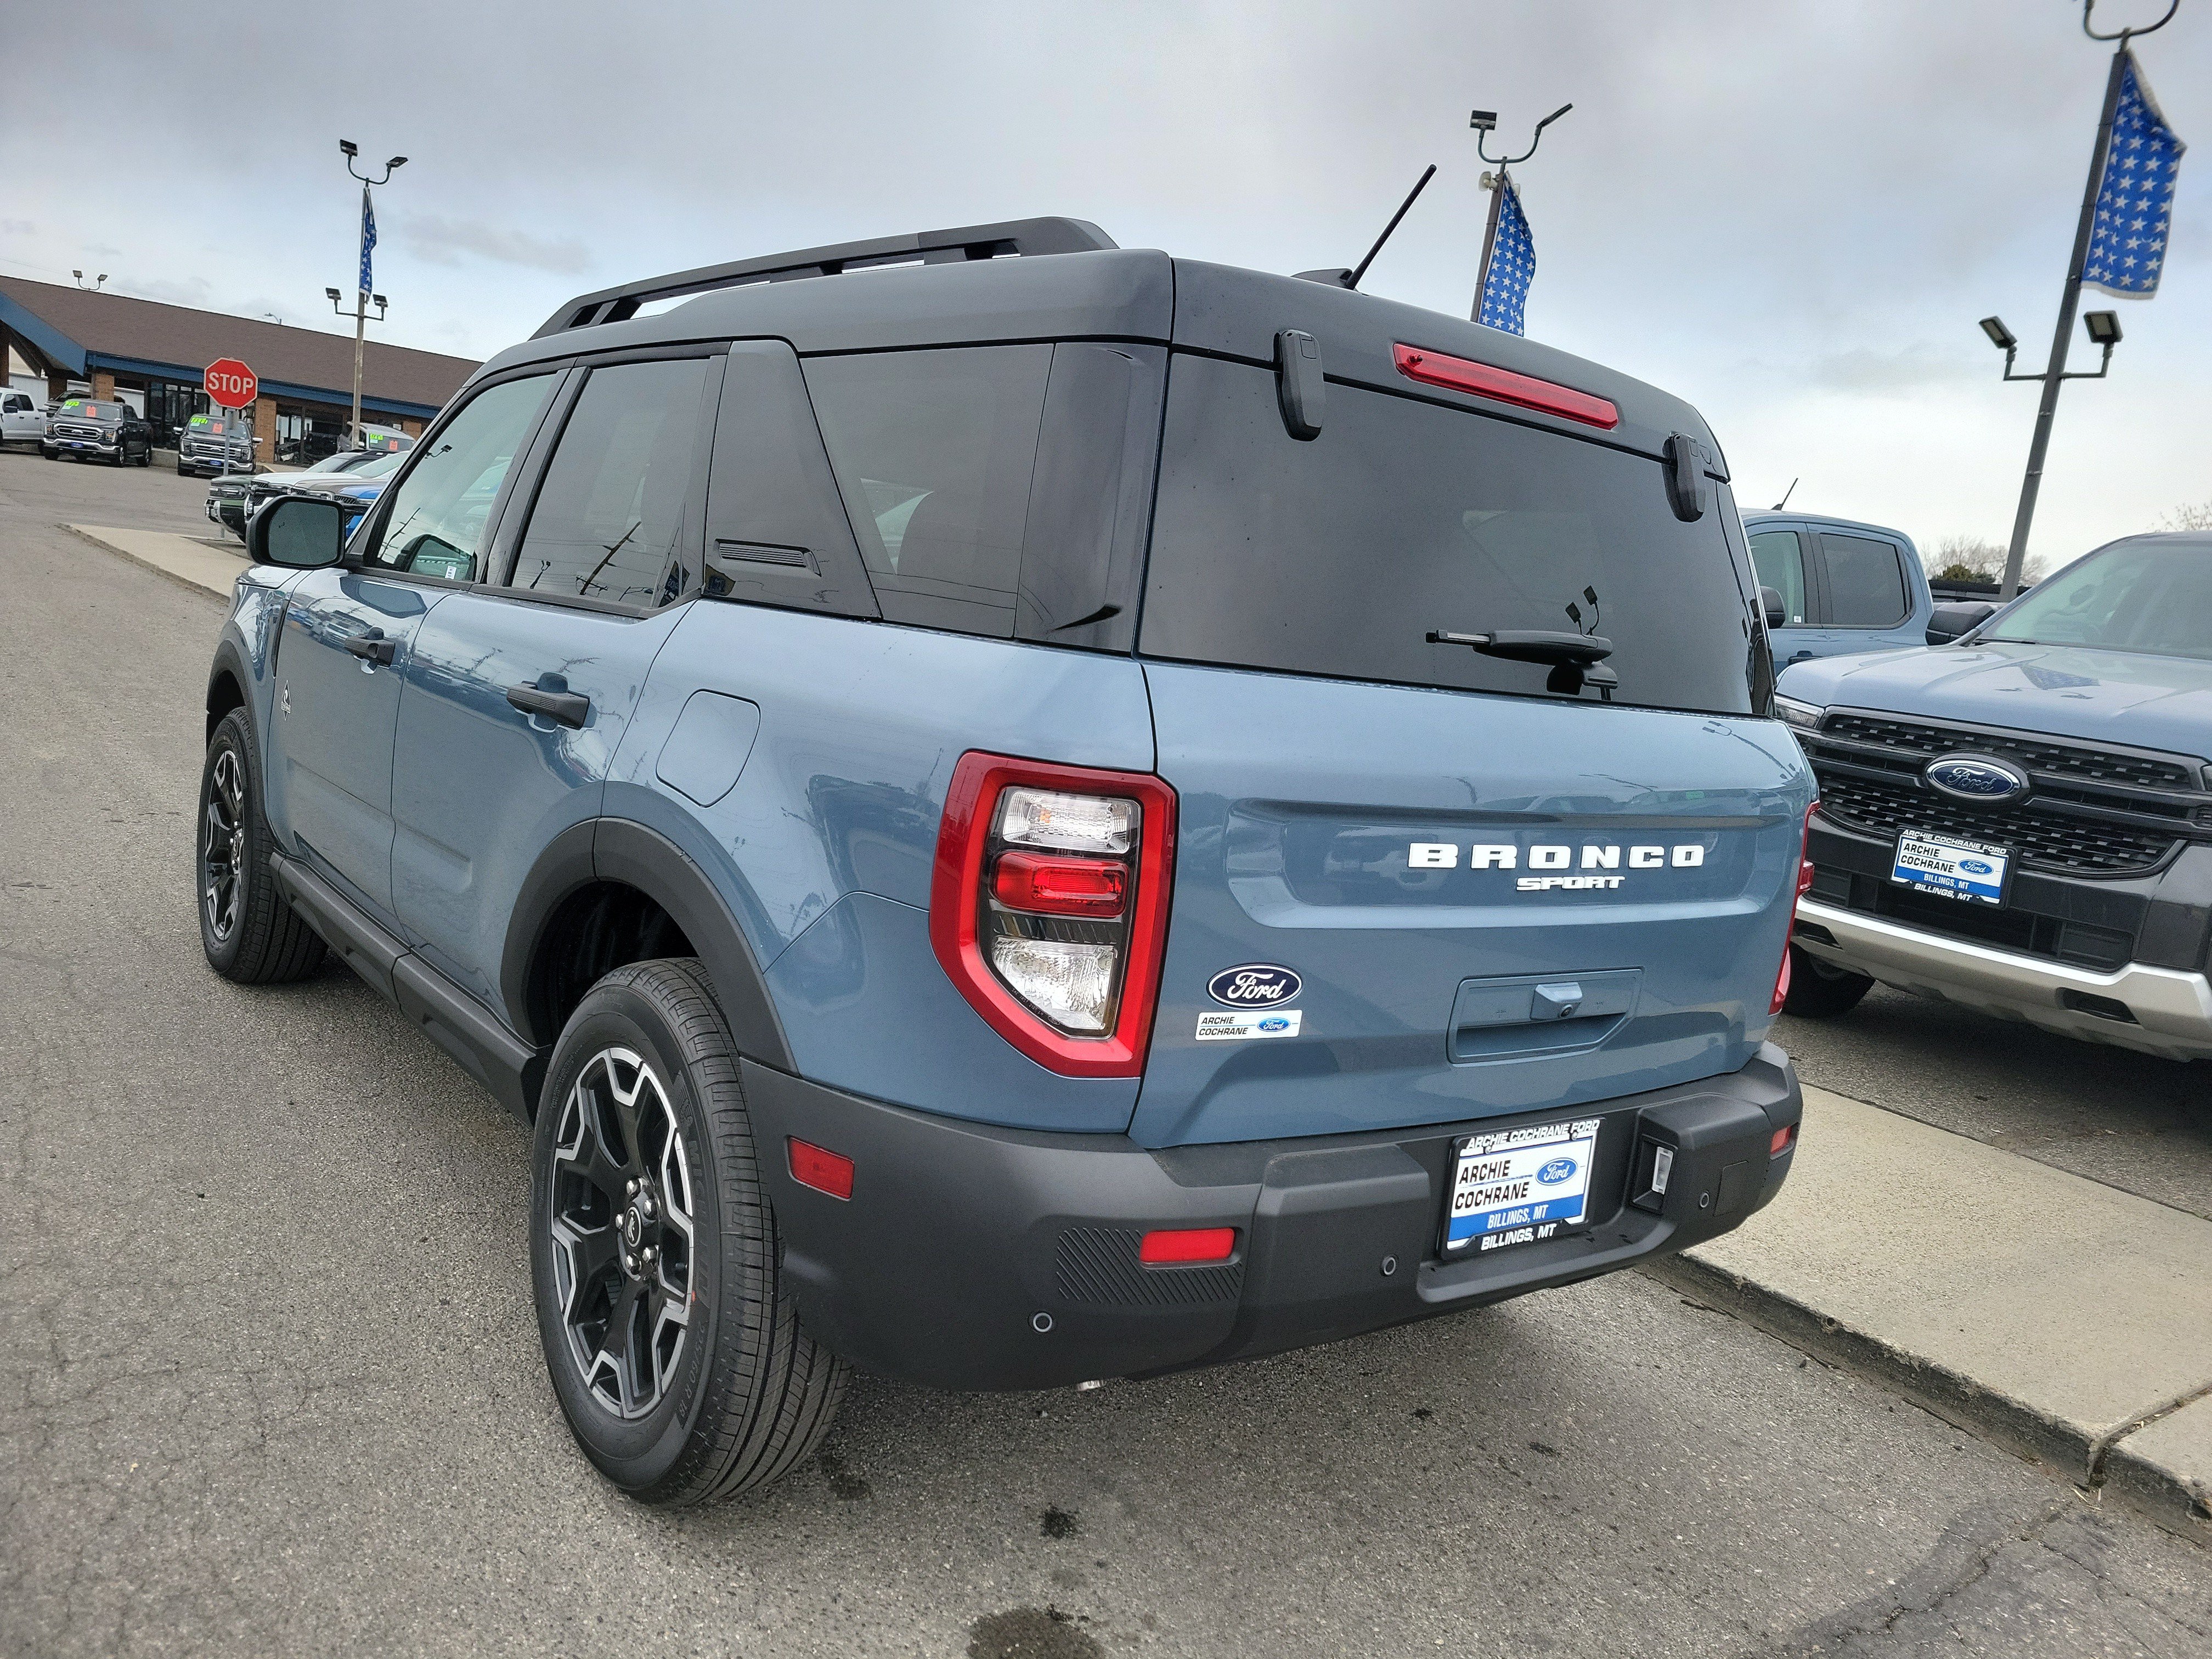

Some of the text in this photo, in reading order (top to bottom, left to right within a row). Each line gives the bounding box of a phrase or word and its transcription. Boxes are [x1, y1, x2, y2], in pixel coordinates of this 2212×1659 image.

[208, 372, 253, 394] STOP
[1946, 766, 1997, 792] Ford
[1903, 830, 2006, 854] ARCHIE COCHRANE FORD
[1903, 843, 1940, 857] ARCHIE
[1408, 842, 1705, 870] BRONCO
[1901, 855, 1955, 873] COCHRANE
[1965, 861, 1986, 873] Ford
[1516, 876, 1626, 891] SPORT
[1924, 873, 1970, 890] BILLINGS, MT
[1914, 883, 1973, 901] BILLINGS, MT
[1227, 972, 1286, 999] Ford
[1201, 1017, 1235, 1025] ARCHIE
[1263, 1019, 1284, 1030] Ford
[1199, 1027, 1248, 1036] COCHRANE
[1466, 1119, 1600, 1149] ARCHIE COCHRANE FORD
[1459, 1159, 1511, 1184] ARCHIE
[1543, 1162, 1569, 1181] Ford
[1455, 1181, 1530, 1210] COCHRANE
[1487, 1204, 1549, 1229] BILLINGS, MT
[1480, 1223, 1557, 1251] BILLINGS, MT
